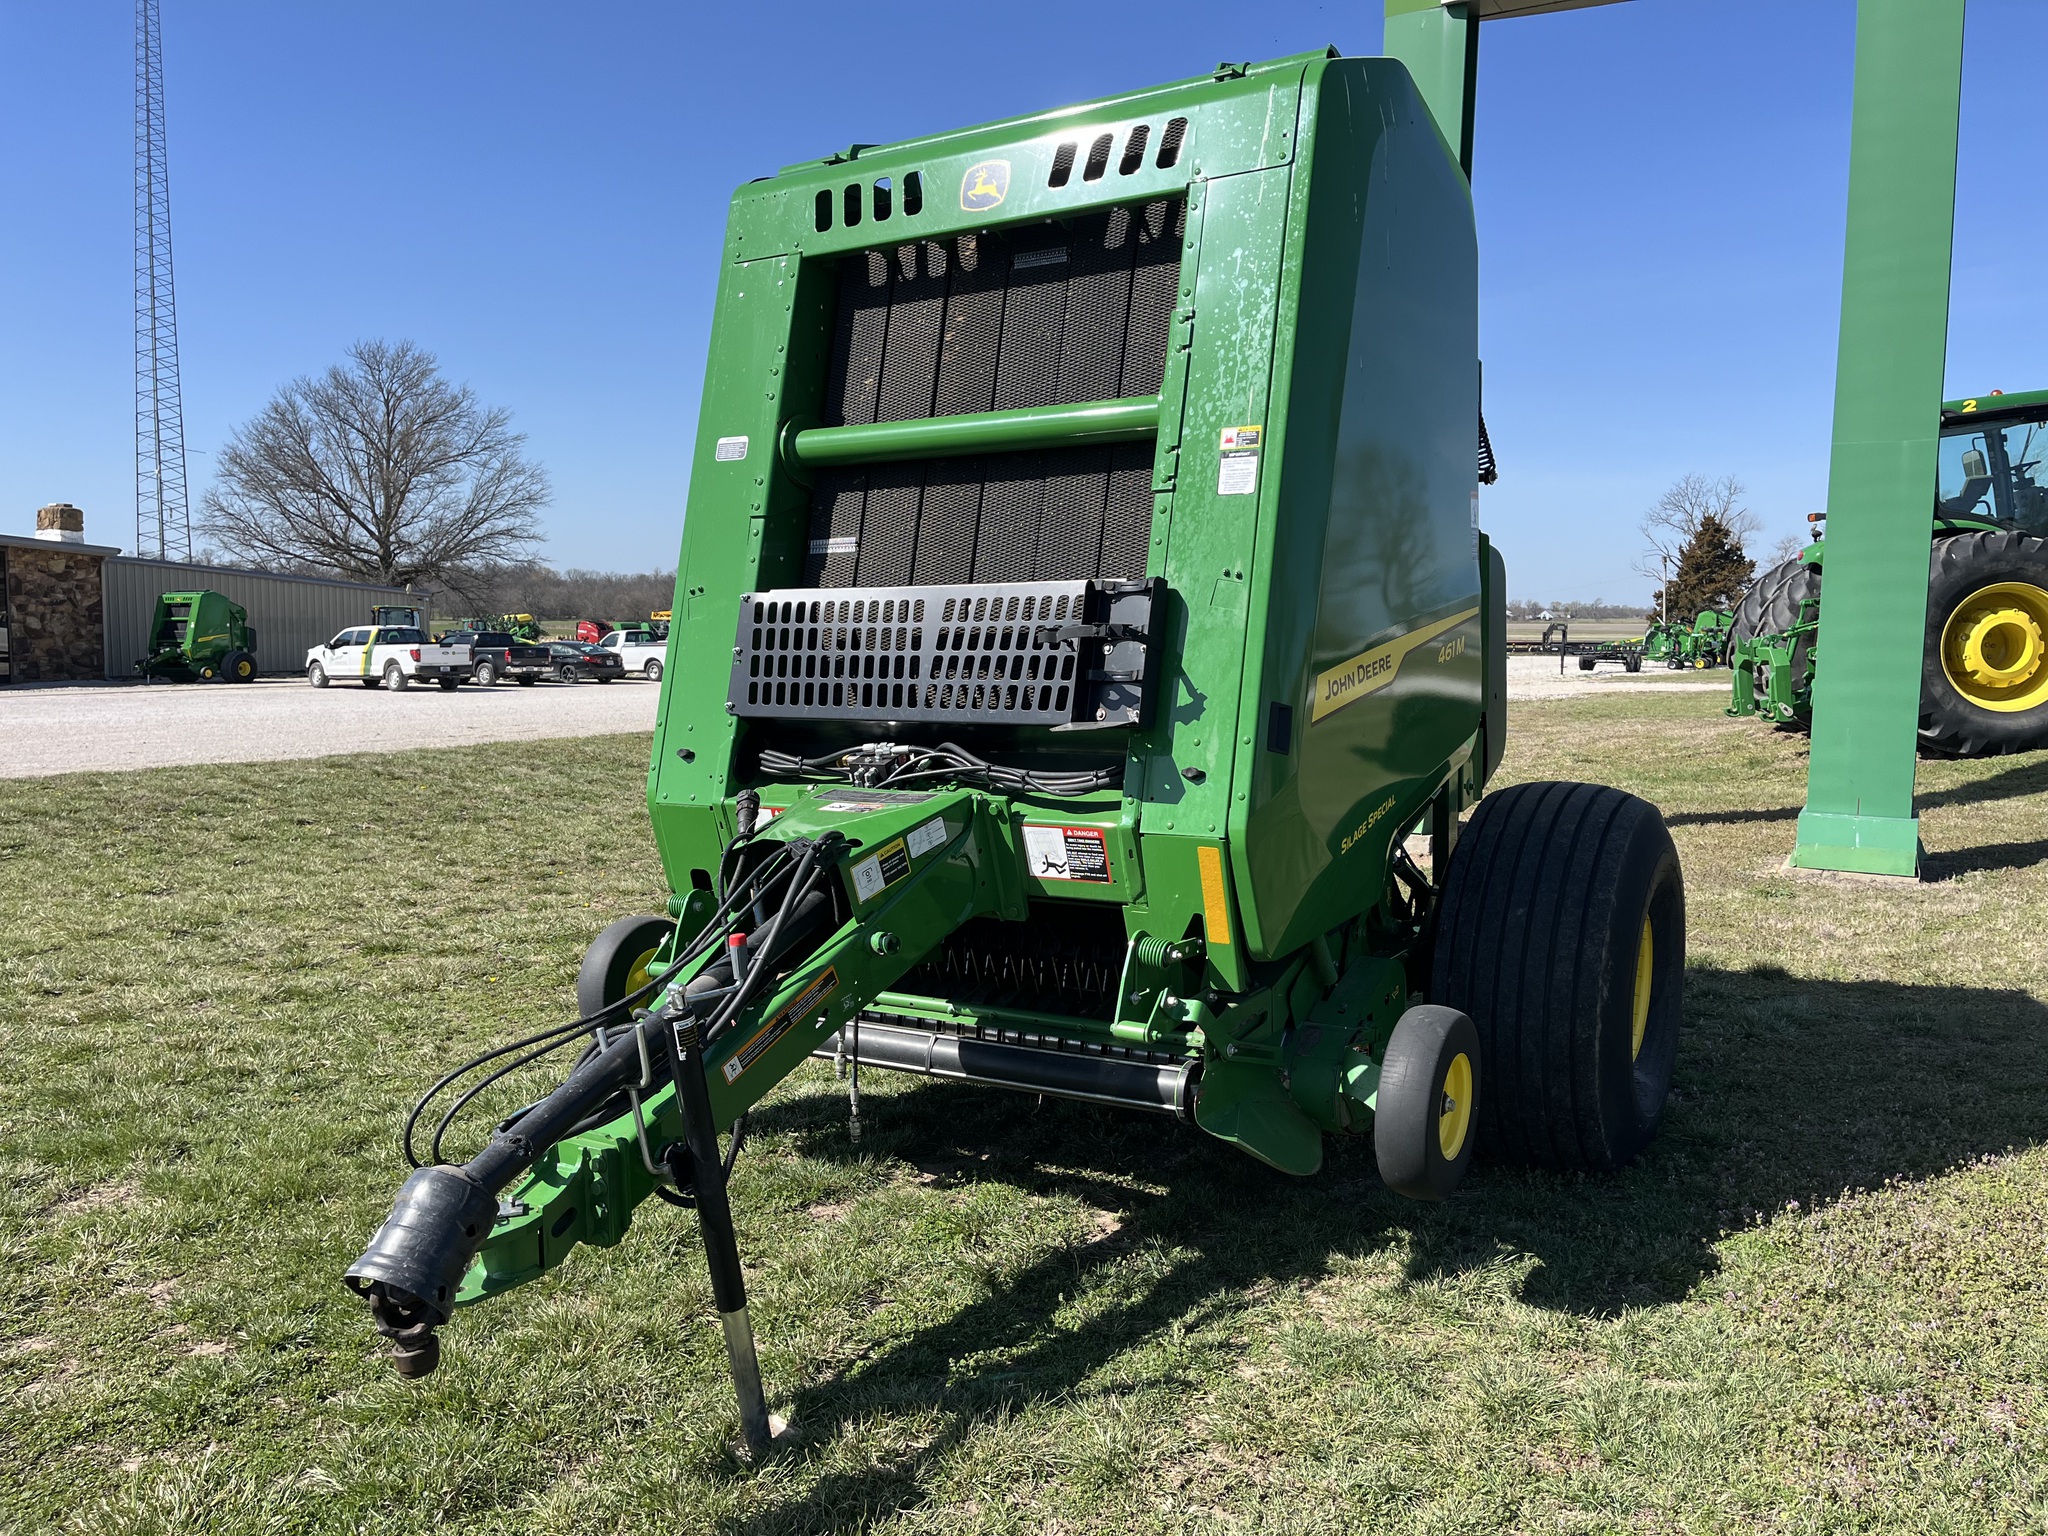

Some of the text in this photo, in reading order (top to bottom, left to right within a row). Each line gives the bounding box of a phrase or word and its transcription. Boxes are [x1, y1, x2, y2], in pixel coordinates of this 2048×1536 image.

[1962, 399, 1977, 413] 2
[1438, 635, 1465, 664] 461M
[1325, 654, 1392, 700] JOHN DEERE
[1341, 794, 1397, 855] SILAGE SPECIAL
